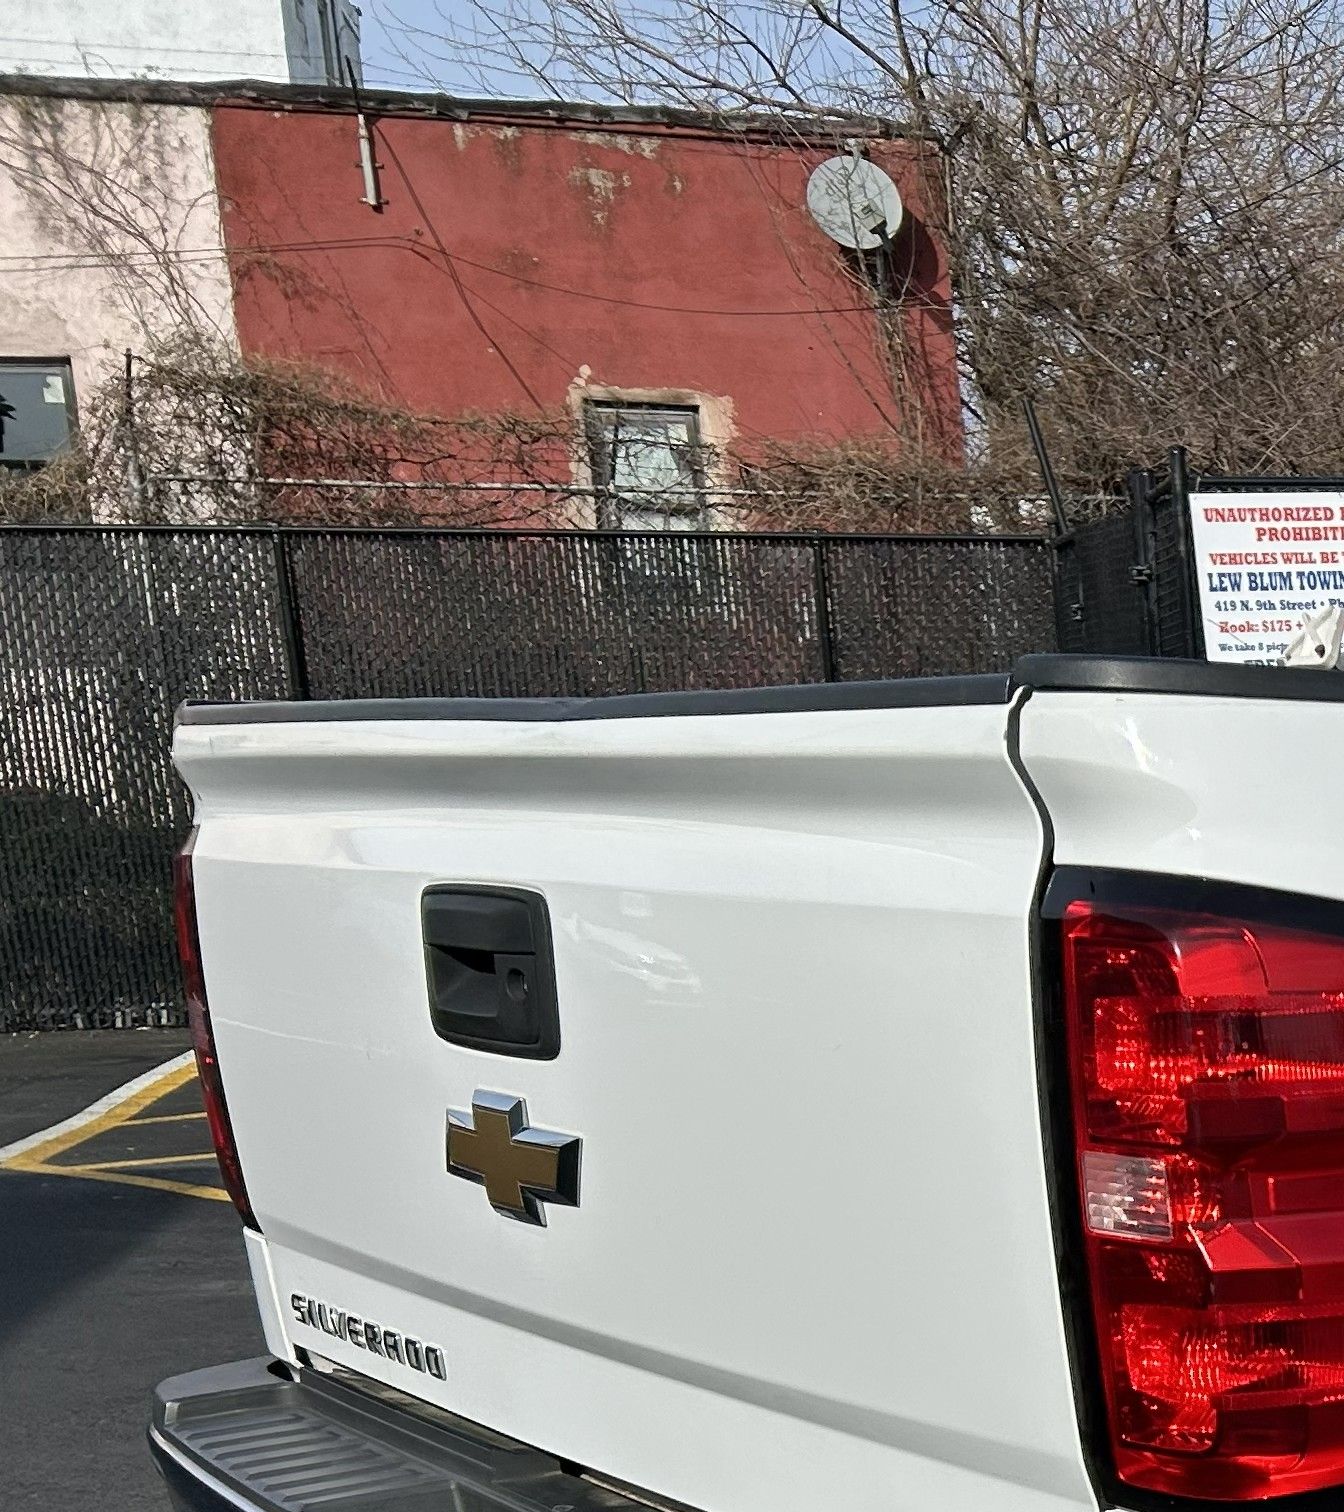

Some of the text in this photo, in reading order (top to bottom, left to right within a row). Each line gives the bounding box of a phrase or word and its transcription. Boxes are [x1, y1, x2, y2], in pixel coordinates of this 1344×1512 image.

[1203, 507, 1334, 522] UNAUTHORIZED
[1209, 552, 1278, 566] VEHICLES
[1280, 552, 1316, 564] WILL
[1320, 551, 1339, 564] BE
[1207, 572, 1242, 592] LEW
[1247, 571, 1293, 592] BLUM
[1214, 600, 1237, 612] 419
[1240, 600, 1253, 611] N.
[1256, 600, 1277, 611] 9th
[1280, 599, 1316, 611] Street
[1262, 620, 1292, 633] $175
[1218, 642, 1233, 652] We
[1234, 642, 1256, 651] take
[291, 1293, 447, 1381] SILVERADO
